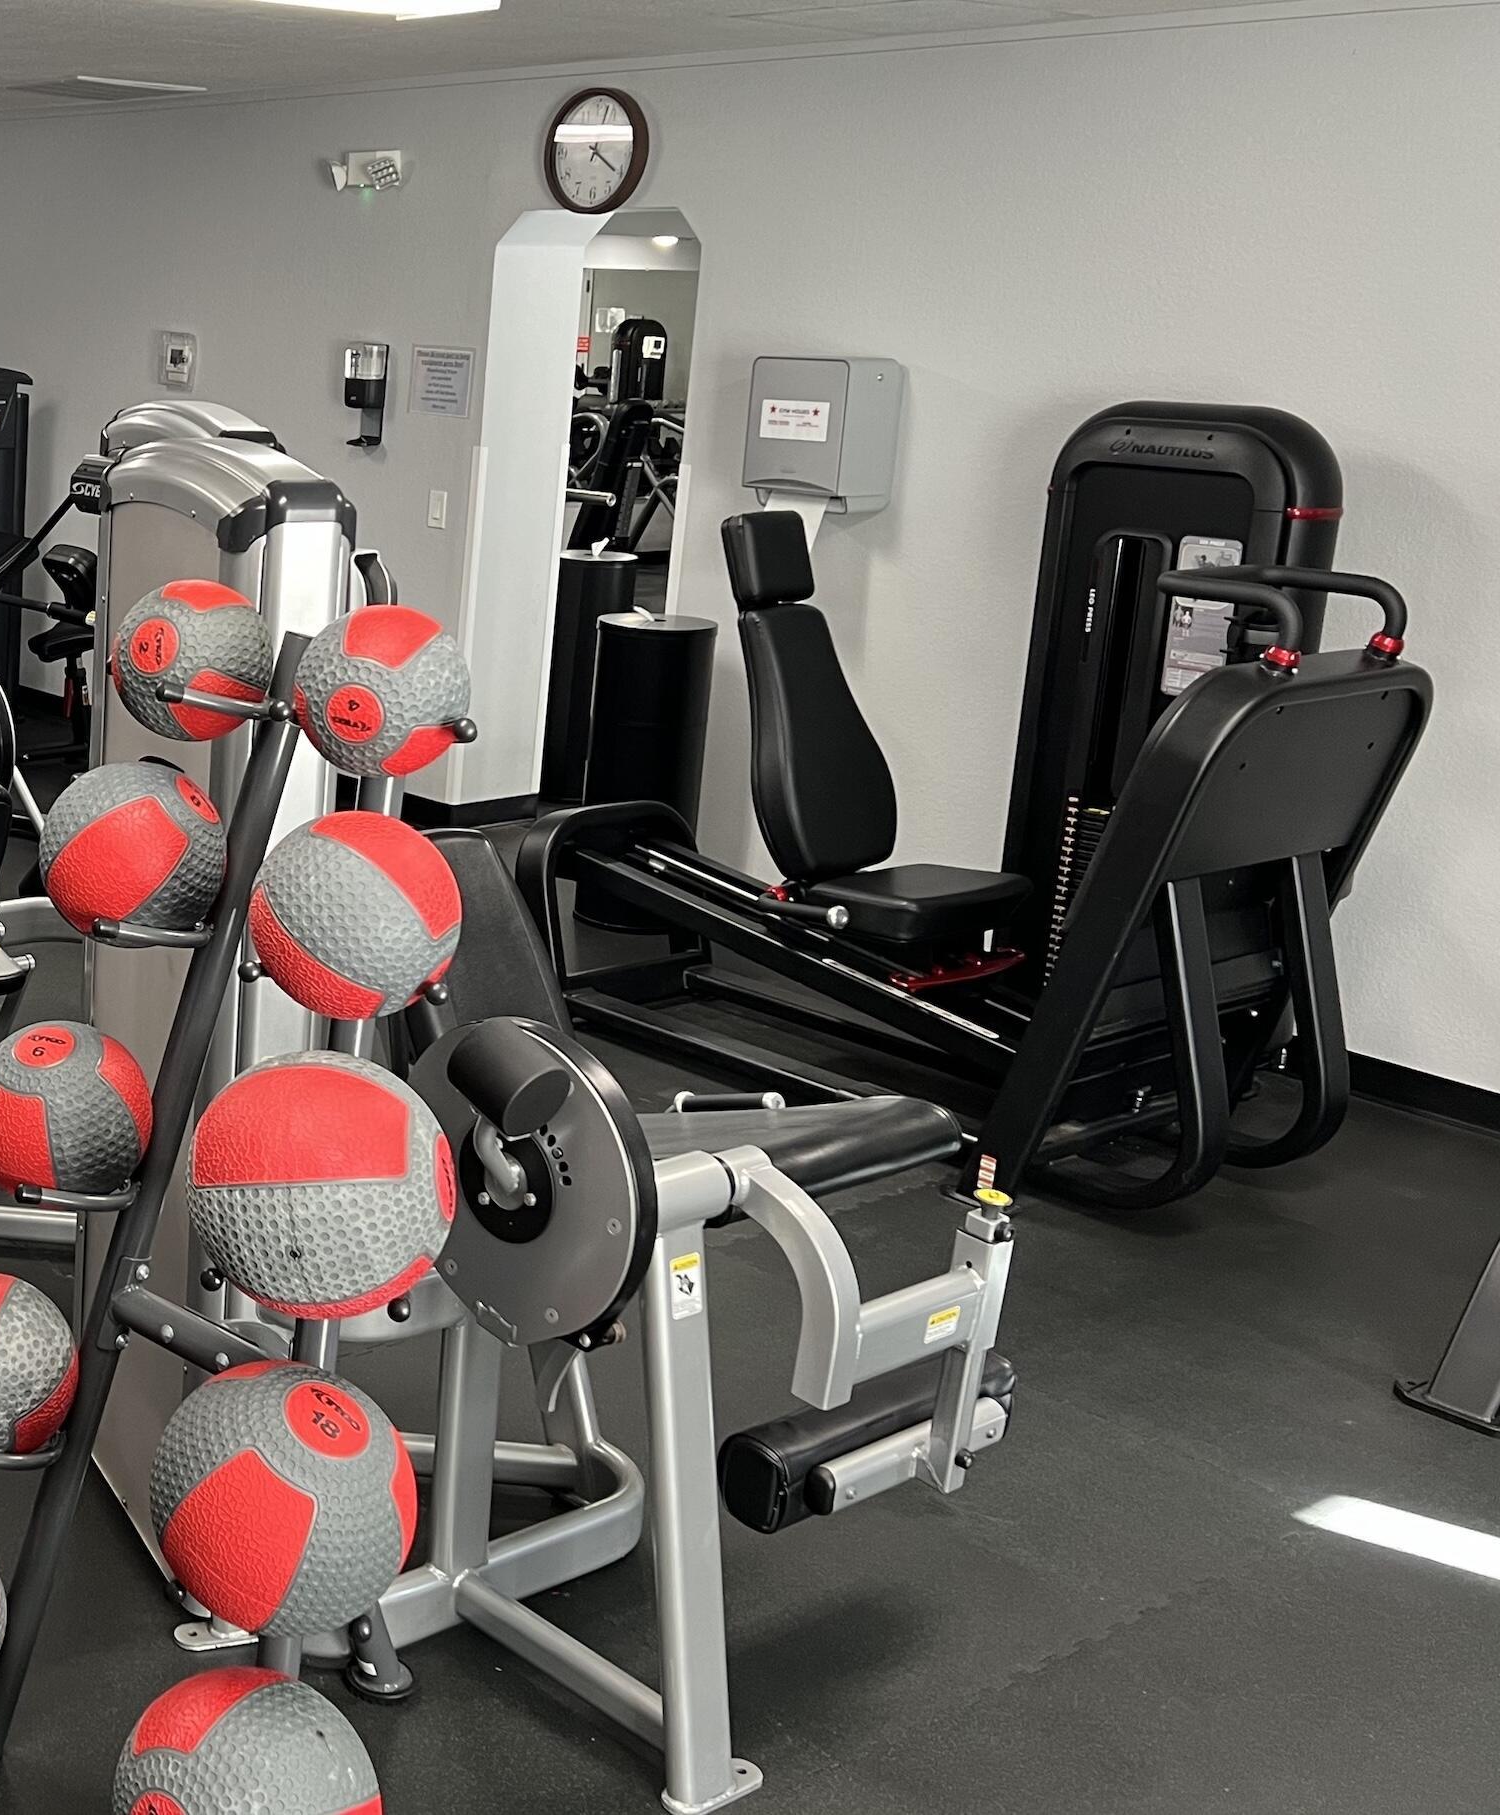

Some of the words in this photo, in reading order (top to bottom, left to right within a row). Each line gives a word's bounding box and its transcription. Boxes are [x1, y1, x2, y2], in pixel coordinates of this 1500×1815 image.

[1131, 445, 1214, 460] NAUTILUS
[139, 641, 149, 654] 2
[348, 699, 360, 711] 4
[32, 1046, 46, 1057] 6
[312, 1410, 340, 1438] 18
